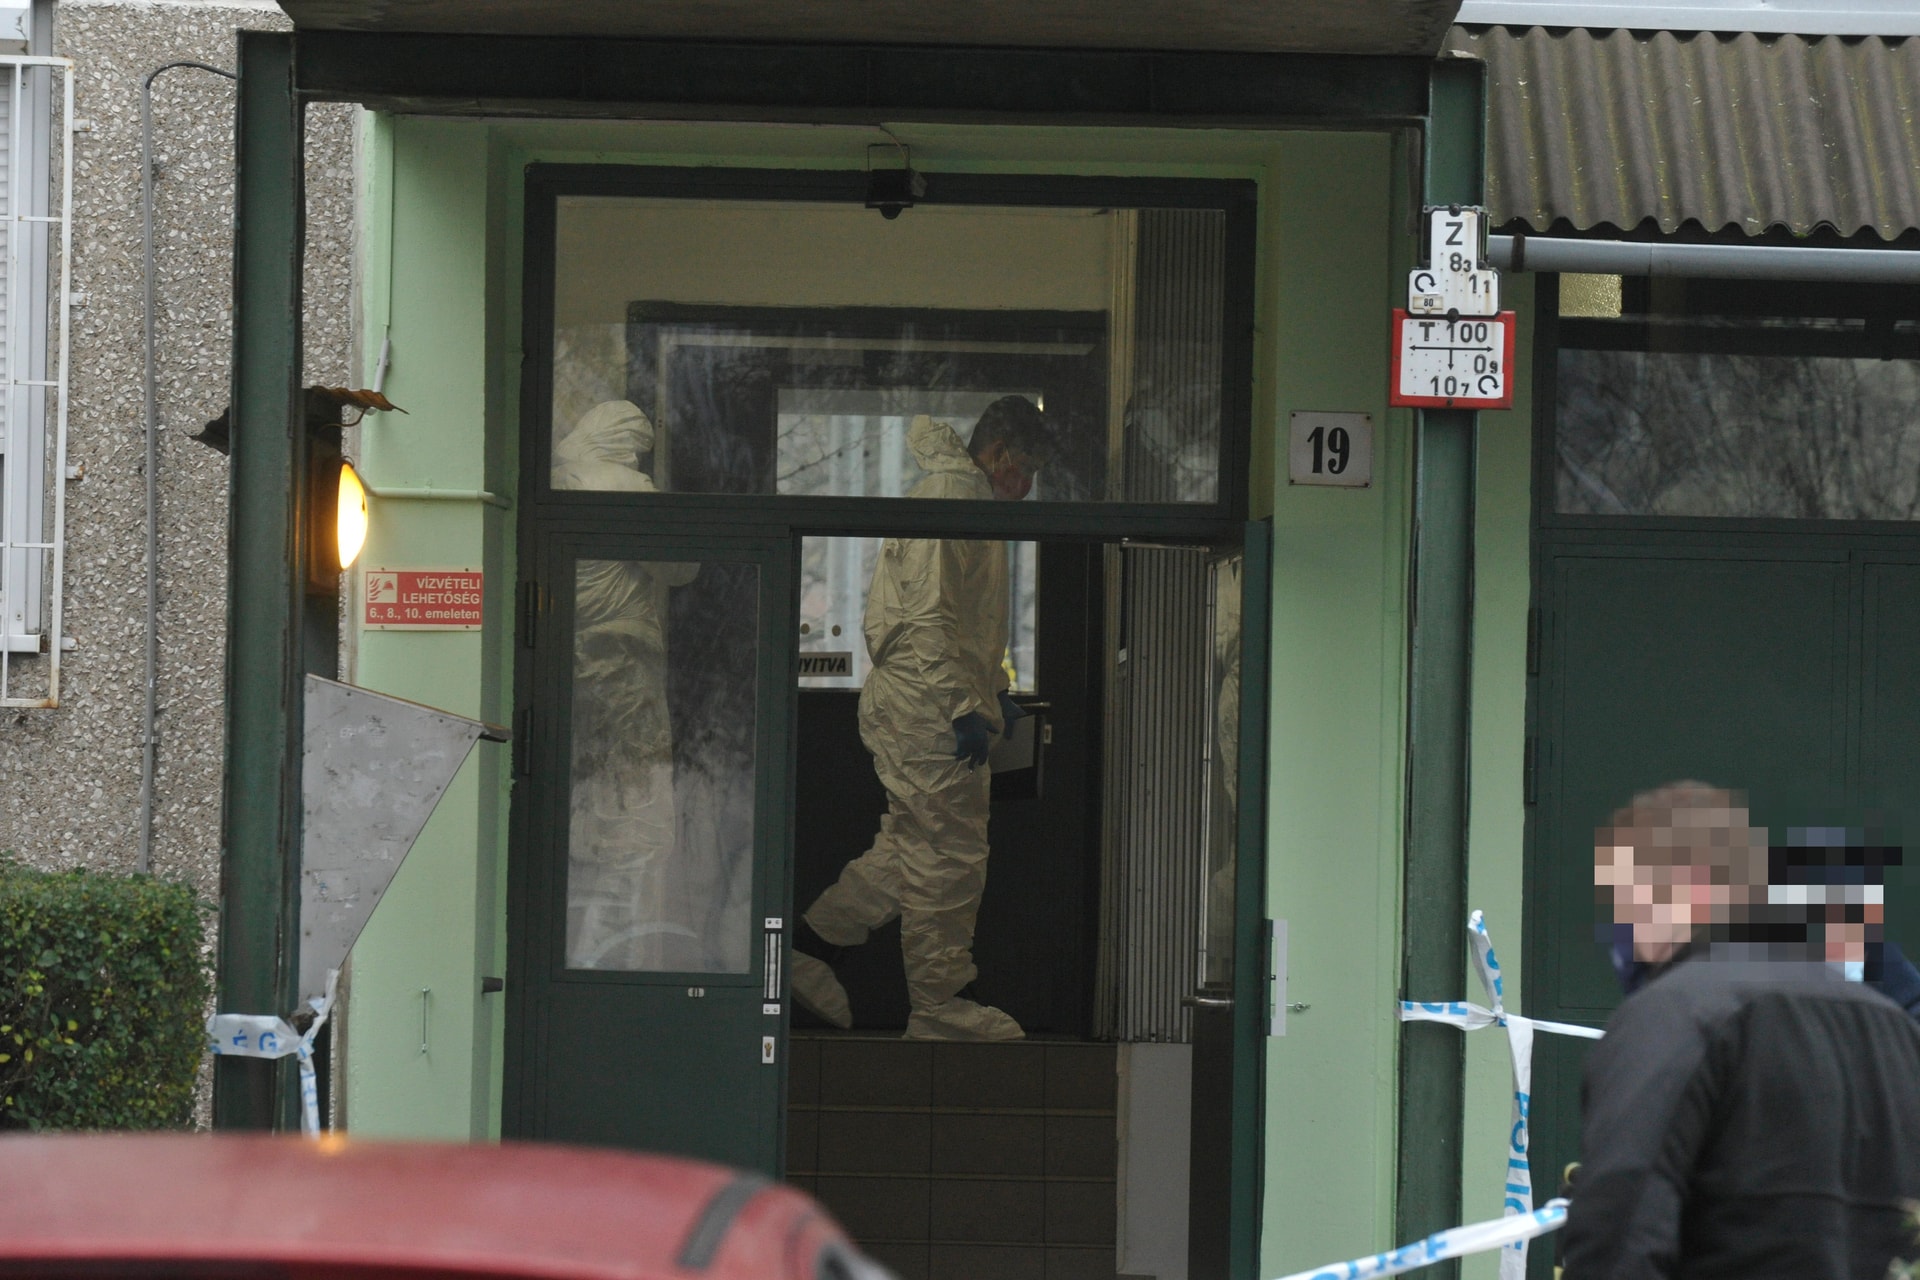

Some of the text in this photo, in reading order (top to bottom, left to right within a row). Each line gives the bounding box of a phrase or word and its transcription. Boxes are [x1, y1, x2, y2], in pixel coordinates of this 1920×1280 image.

[1445, 222, 1463, 246] Z
[1423, 298, 1434, 307] 80
[1419, 322, 1487, 343] T 100
[1307, 427, 1350, 474] 19
[417, 576, 480, 589] VÍZVÉTELI
[403, 592, 480, 604] LEHETŐSÉG
[369, 608, 479, 620] 6., 8., 10. emeleten
